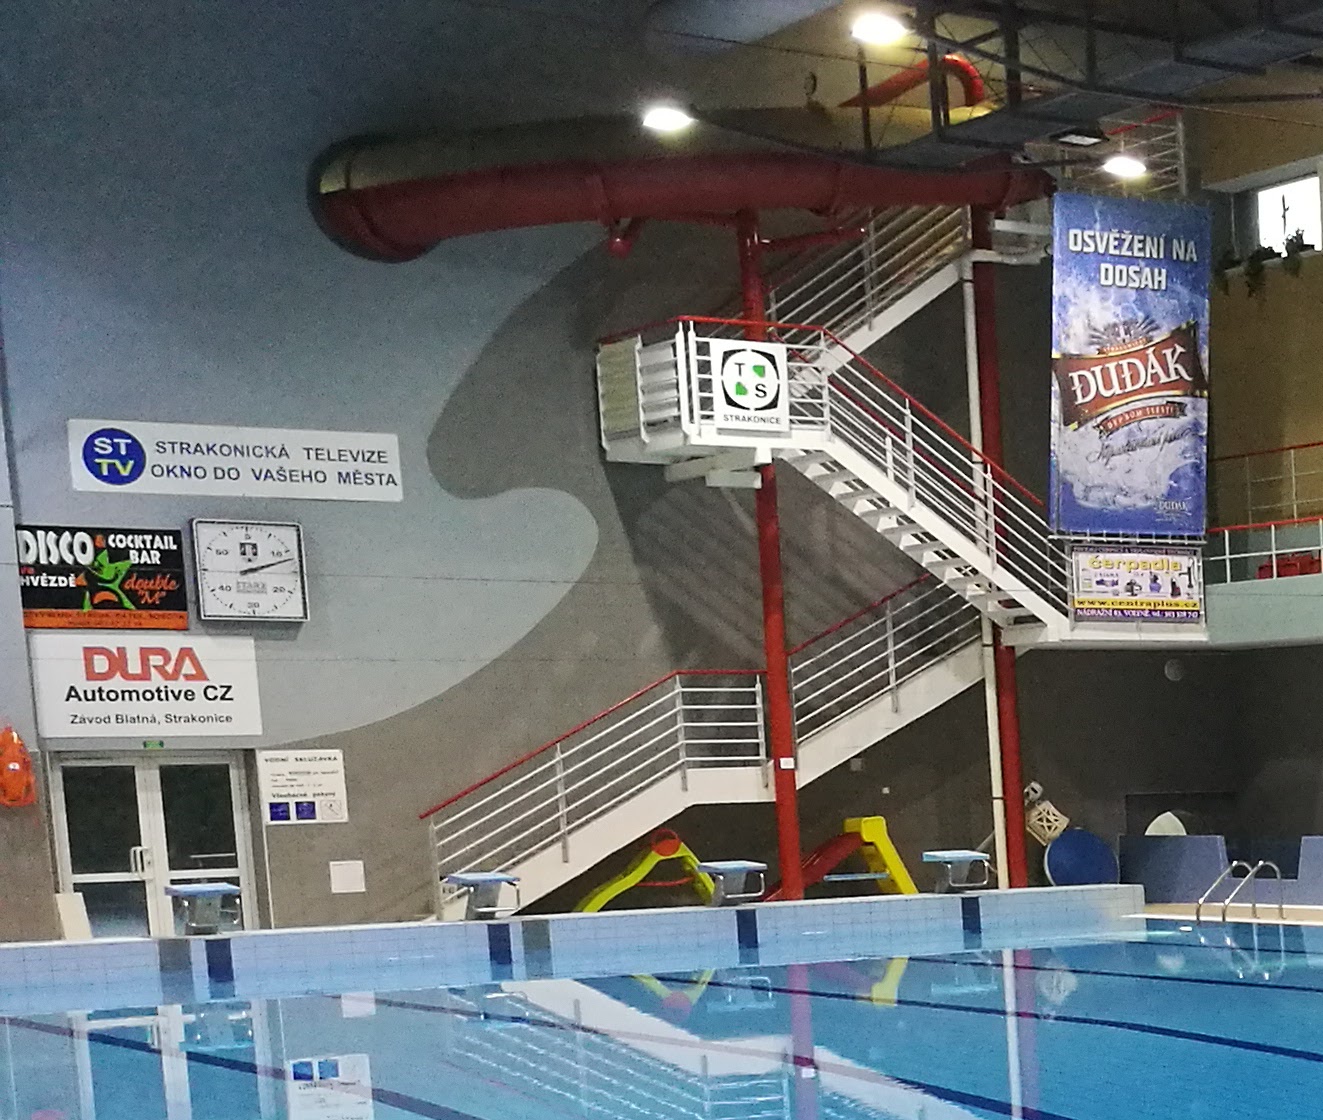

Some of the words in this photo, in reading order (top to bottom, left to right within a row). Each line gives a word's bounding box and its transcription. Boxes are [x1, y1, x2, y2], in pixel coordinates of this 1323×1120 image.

[1068, 228, 1166, 259] OSVĚŽENÍ
[1172, 238, 1198, 262] NA
[1100, 262, 1168, 290] DOSAH
[1068, 343, 1194, 406] DUDÁK
[723, 414, 781, 425] STRAKONICE
[94, 437, 132, 455] ST
[155, 440, 291, 460] STRAKONICKÁ
[303, 446, 389, 464] TELEVIZE
[94, 458, 135, 477] TV
[151, 463, 207, 480] OKNO
[213, 466, 241, 481] DO
[250, 466, 328, 484] VAŠEHO
[337, 469, 398, 487] MĚSTA
[17, 530, 94, 566] DISCO
[108, 534, 178, 550] COCKTAIL
[129, 550, 161, 565] BAR
[123, 573, 179, 591] double
[1077, 600, 1199, 609] www.centraplus.cz
[83, 646, 210, 682] DURA
[65, 686, 196, 702] Automotive
[203, 685, 234, 701] CZ
[70, 714, 111, 725] Závod
[115, 713, 161, 726] Blatná,
[164, 713, 233, 724] Strakonice
